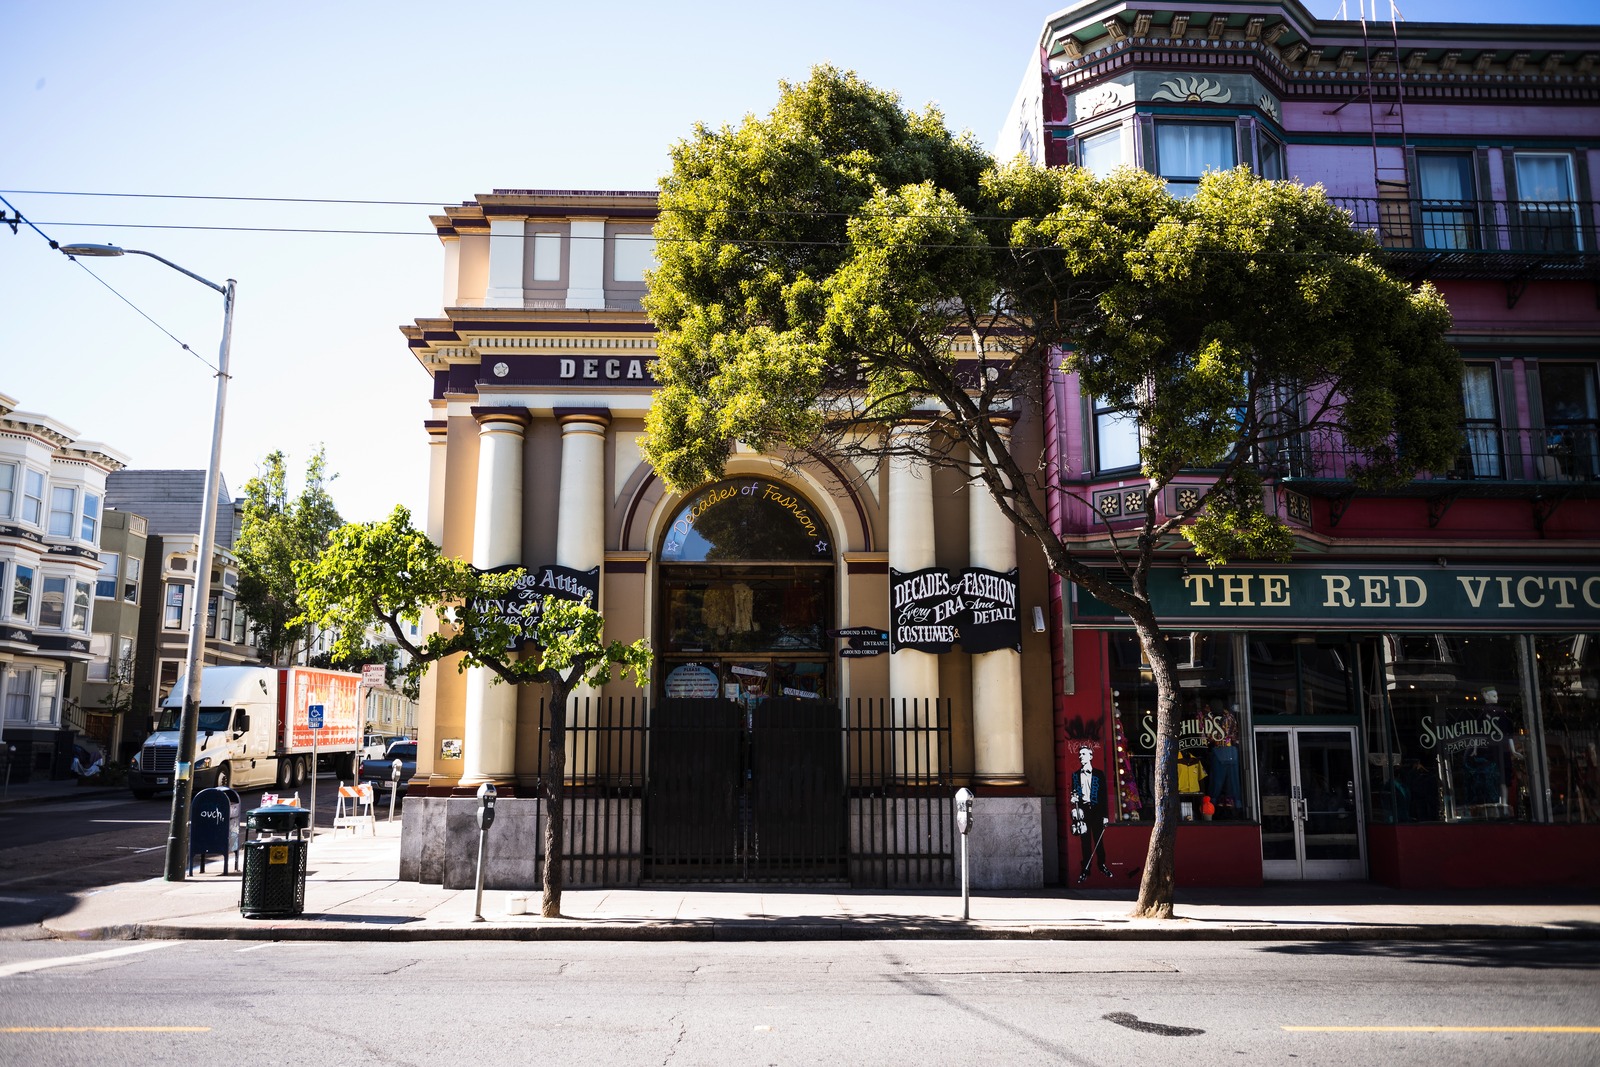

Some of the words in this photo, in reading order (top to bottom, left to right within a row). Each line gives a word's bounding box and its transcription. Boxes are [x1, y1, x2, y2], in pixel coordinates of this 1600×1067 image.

[673, 485, 738, 536] Decades
[741, 482, 759, 496] of
[762, 483, 818, 538] Fashion
[518, 589, 542, 600] For
[540, 569, 594, 600] Attire
[894, 573, 950, 608] DECADES
[950, 579, 965, 596] of
[964, 572, 1017, 610] FASHION
[1184, 574, 1291, 606] THE
[1321, 575, 1428, 607] RED
[524, 616, 540, 627] OF
[898, 602, 931, 625] Every
[933, 595, 966, 624] ERA
[965, 598, 995, 610] And
[973, 607, 1017, 625] DETAIL
[897, 625, 954, 643] COSTUMES
[954, 628, 961, 638] &
[1140, 712, 1225, 749] SHILD'S
[1178, 738, 1208, 750] RLOUR
[1447, 739, 1488, 752] PARLOUR
